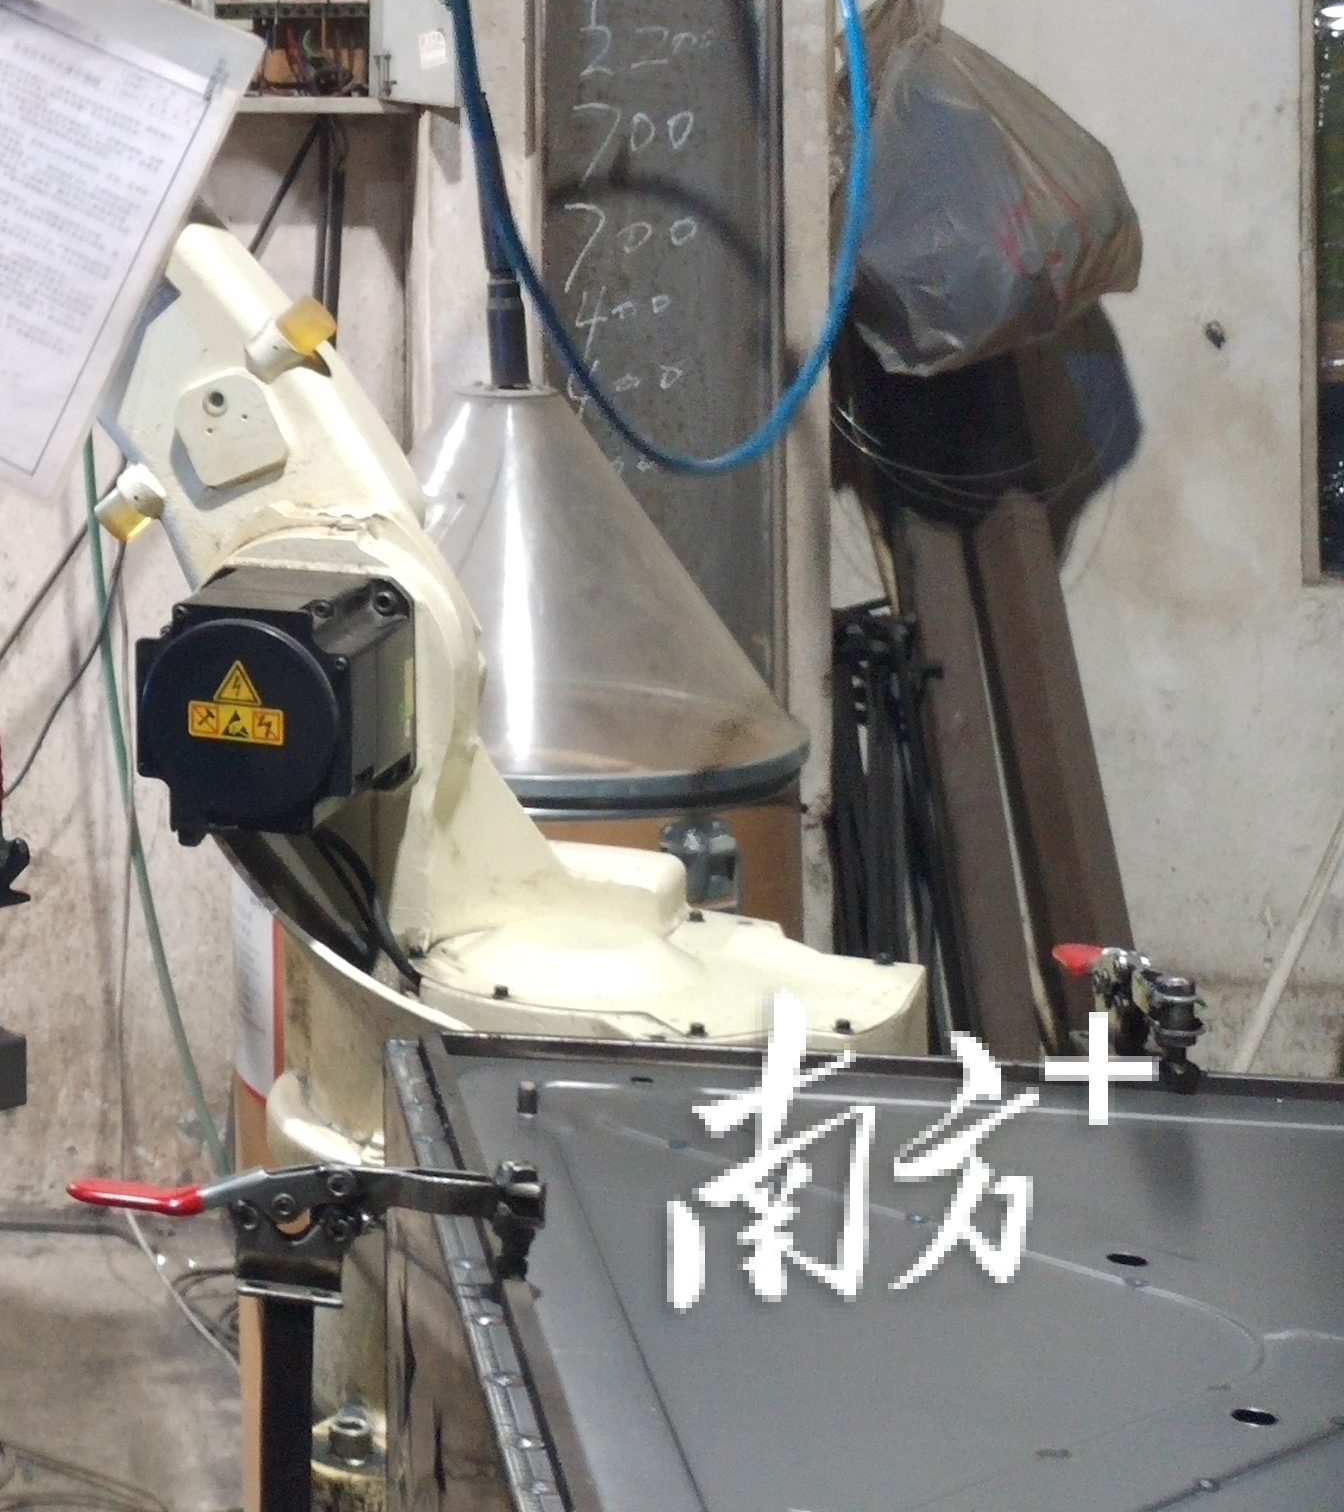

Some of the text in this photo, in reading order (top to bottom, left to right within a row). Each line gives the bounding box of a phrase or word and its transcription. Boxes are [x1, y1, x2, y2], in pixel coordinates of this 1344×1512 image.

[572, 100, 696, 185] 700
[563, 201, 699, 294] 700
[574, 285, 672, 361] 400
